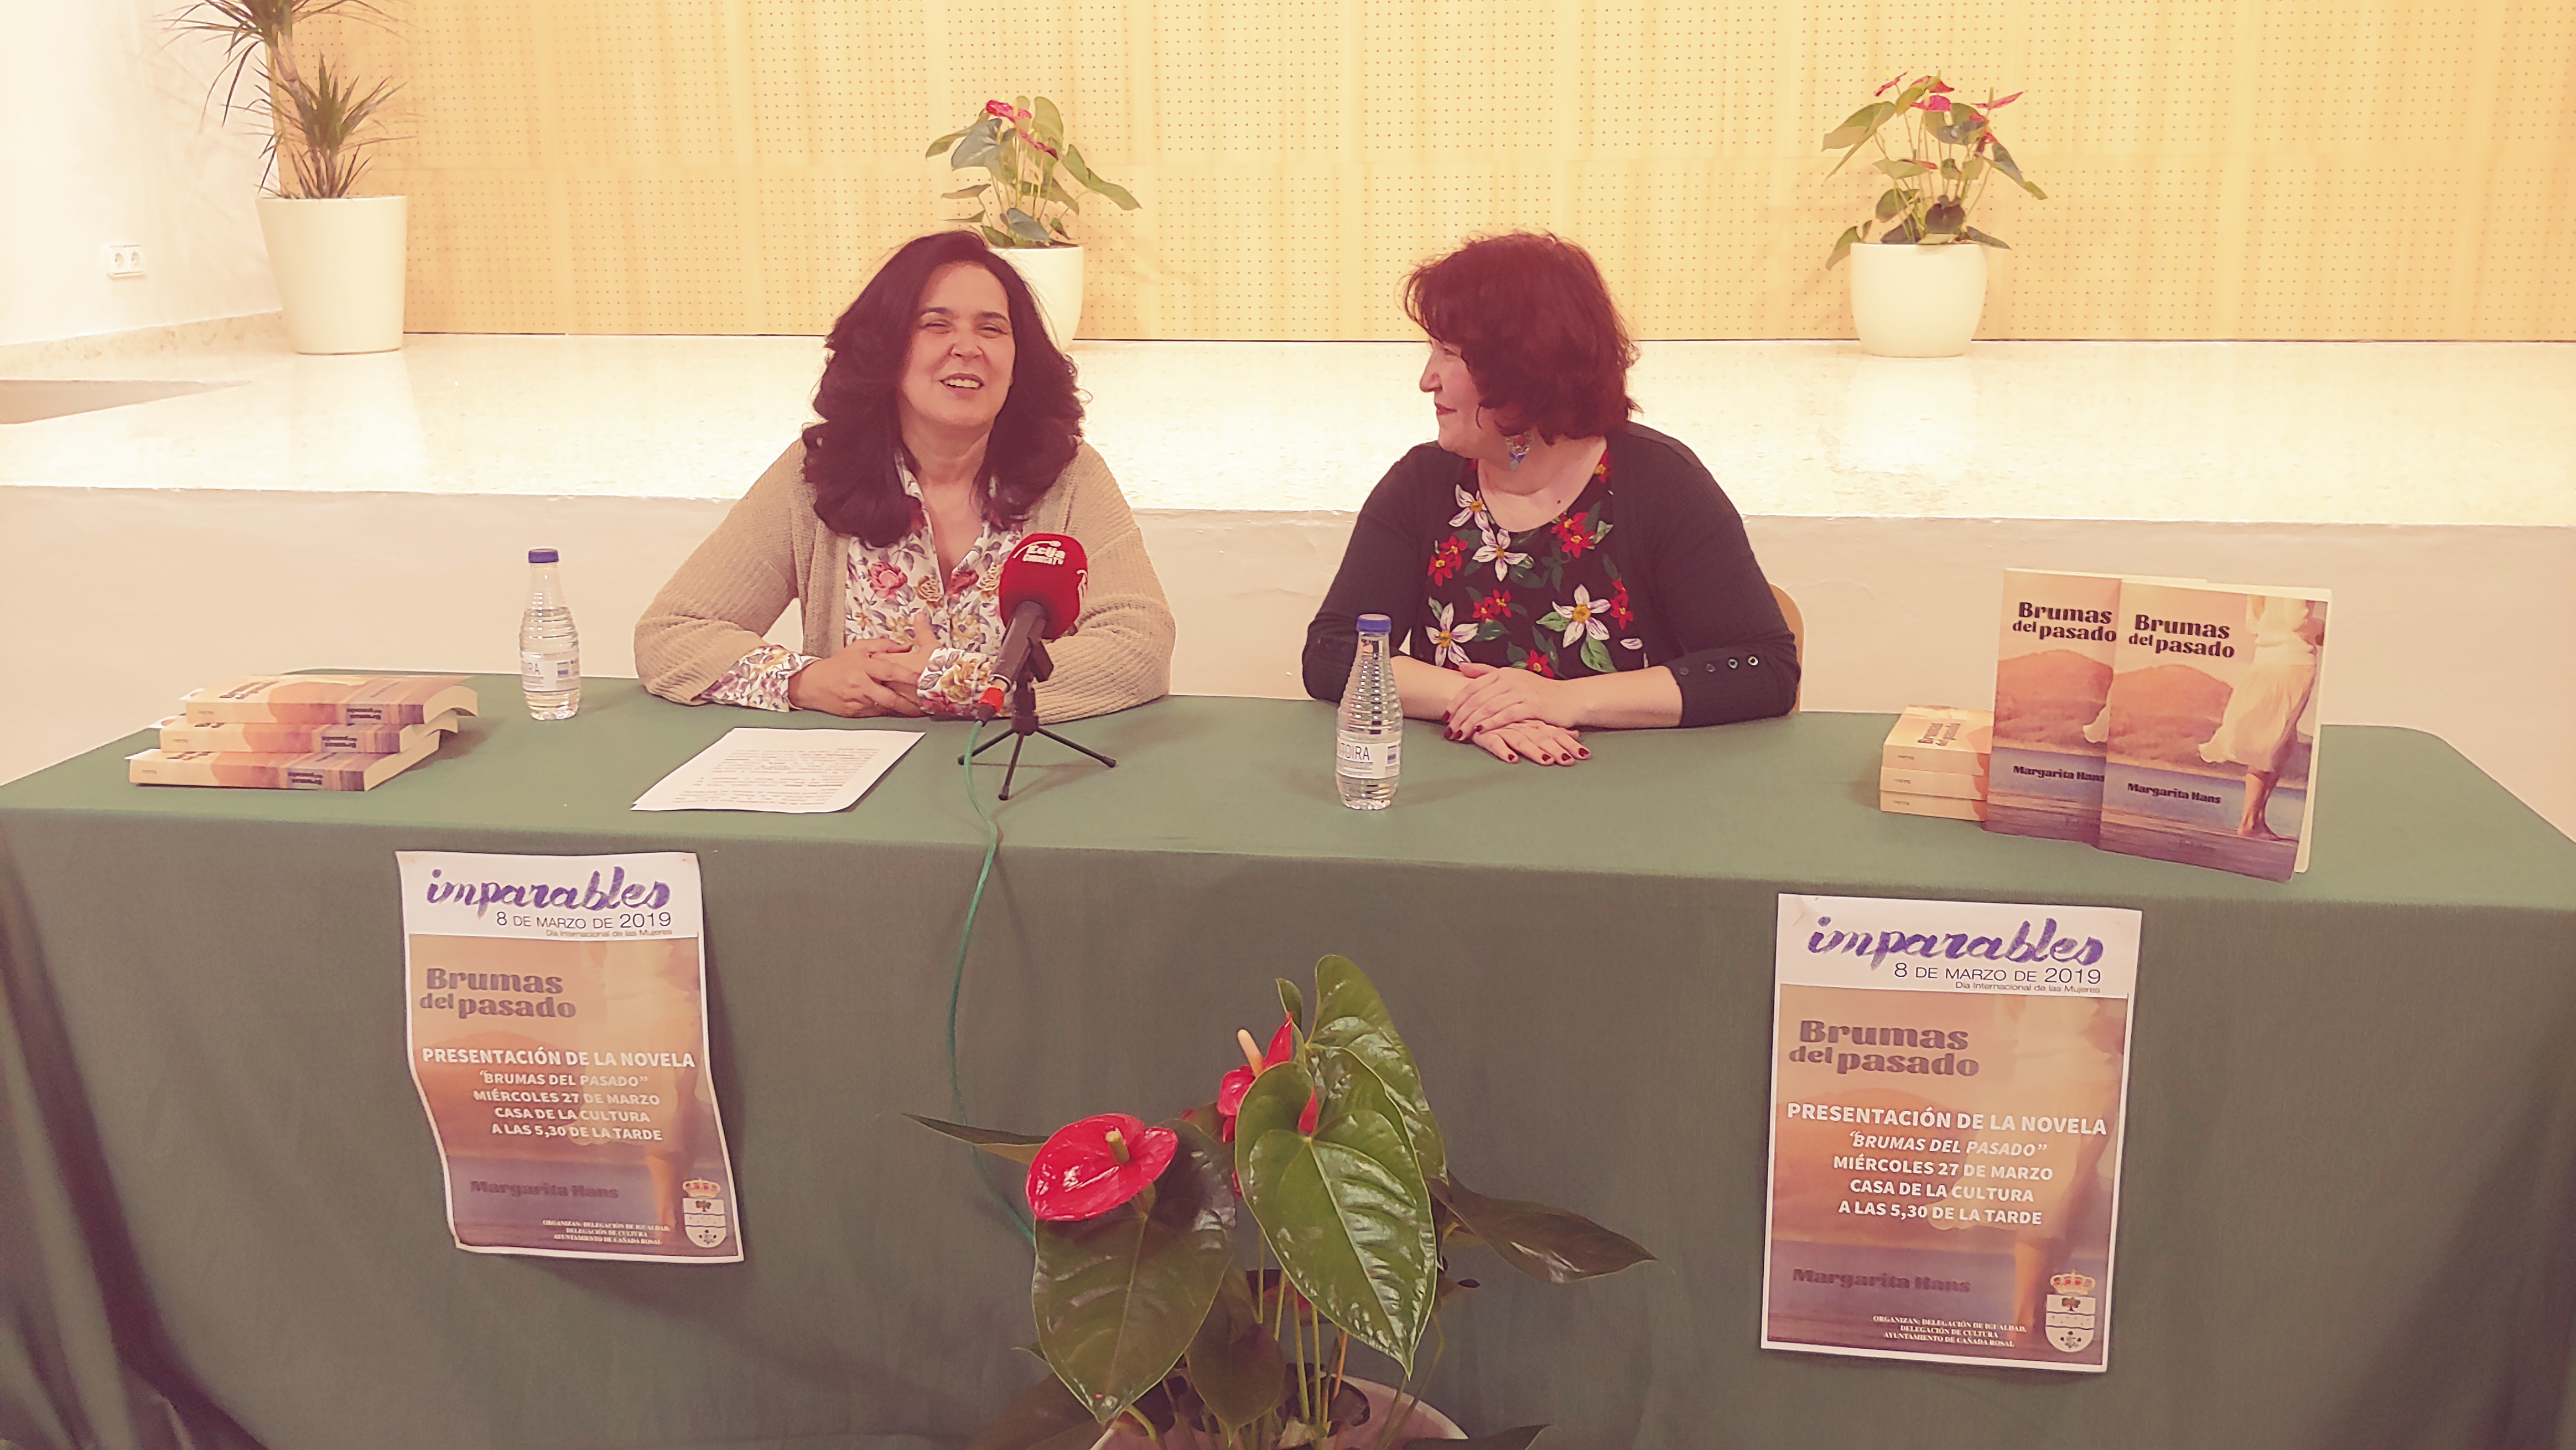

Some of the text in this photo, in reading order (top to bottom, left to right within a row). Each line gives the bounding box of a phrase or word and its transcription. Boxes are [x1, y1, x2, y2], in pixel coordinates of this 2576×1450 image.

[2019, 602, 2113, 624] Brumas
[2012, 620, 2117, 642] del pasado
[2134, 614, 2230, 639] Brumas
[2128, 633, 2235, 658] del pasado
[2013, 765, 2074, 780] Margarita
[2127, 783, 2221, 804] Margarita Hans
[427, 866, 671, 919] imparables
[497, 912, 671, 929] 8 DE MARZO DE 2019
[1808, 916, 2103, 971] imparables
[427, 968, 563, 994] Brumas
[1894, 962, 2101, 984] 8 DE MARZO DE 2019
[1973, 982, 2031, 992] Internacional
[420, 992, 577, 1019] del pasado
[1800, 1020, 1969, 1050] Brumas
[423, 1047, 695, 1067] PRESENTACIÓN DE LA NOVELA
[1789, 1045, 1979, 1076] del pasado
[549, 1075, 576, 1086] DEL
[472, 1088, 661, 1106] MIÉRCOLES 27 DE MARZO
[494, 1107, 651, 1122] CASA DE LA CULTURA
[1787, 1102, 2106, 1135] PRESENTACIÓN DE LA NOVELA
[492, 1123, 663, 1140] A LAS 5,30 DE LA TARDE
[1929, 1140, 1961, 1153] DEL
[1834, 1153, 2053, 1181] MIÉRCOLES 27 DE MARZO
[1850, 1179, 2034, 1203] CASA DE LA CULTURA
[1838, 1200, 2042, 1225] A LAS 5,30 DE LA TARDE
[1794, 1268, 1971, 1293] Margarita Hans
[1963, 1330, 1998, 1338] CULTURA
